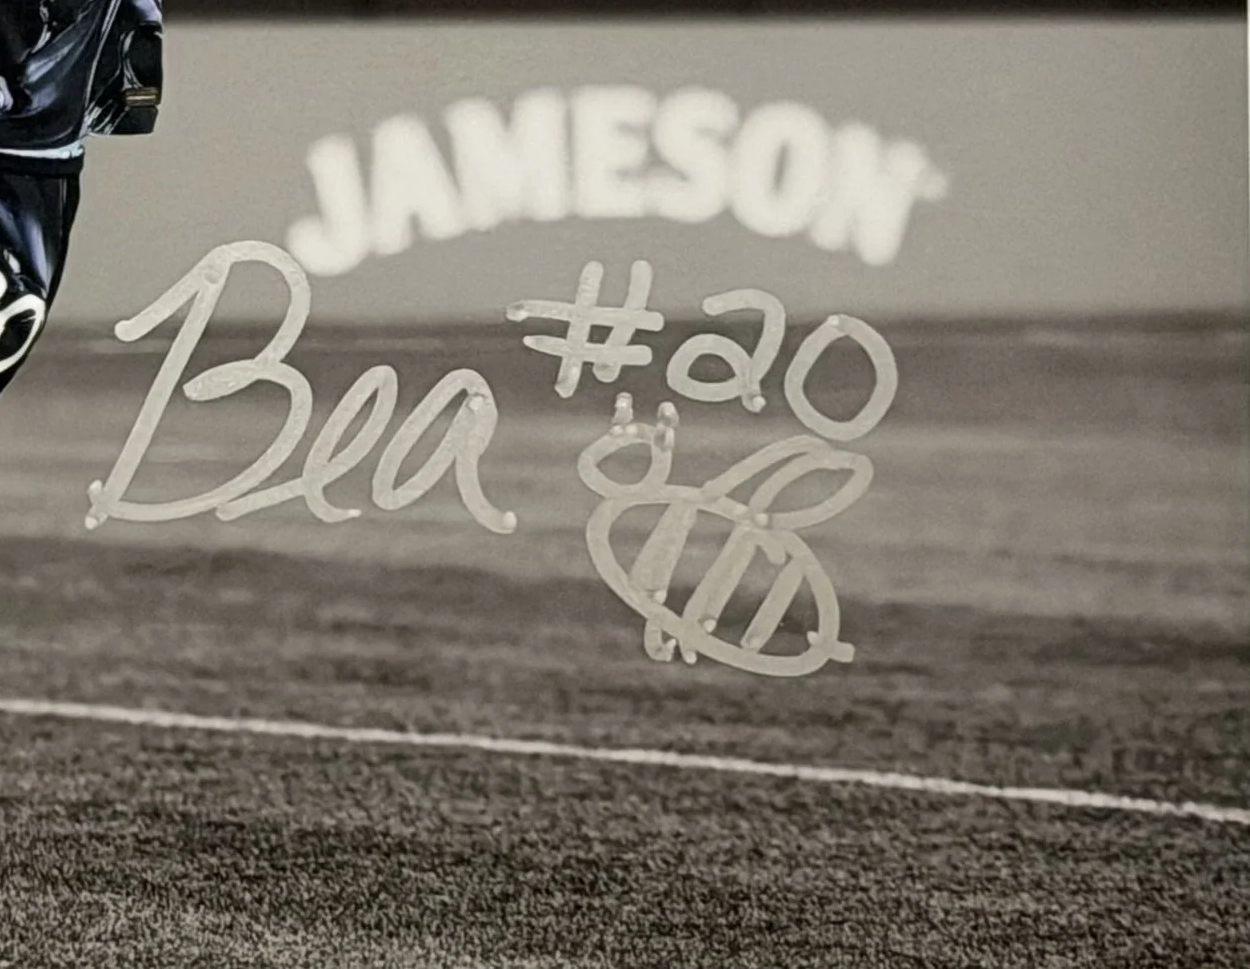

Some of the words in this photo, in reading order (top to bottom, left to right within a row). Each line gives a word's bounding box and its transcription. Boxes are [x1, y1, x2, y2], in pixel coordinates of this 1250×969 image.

[286, 86, 928, 276] JAMESON
[85, 239, 518, 533] Bea
[505, 259, 899, 441] #20
